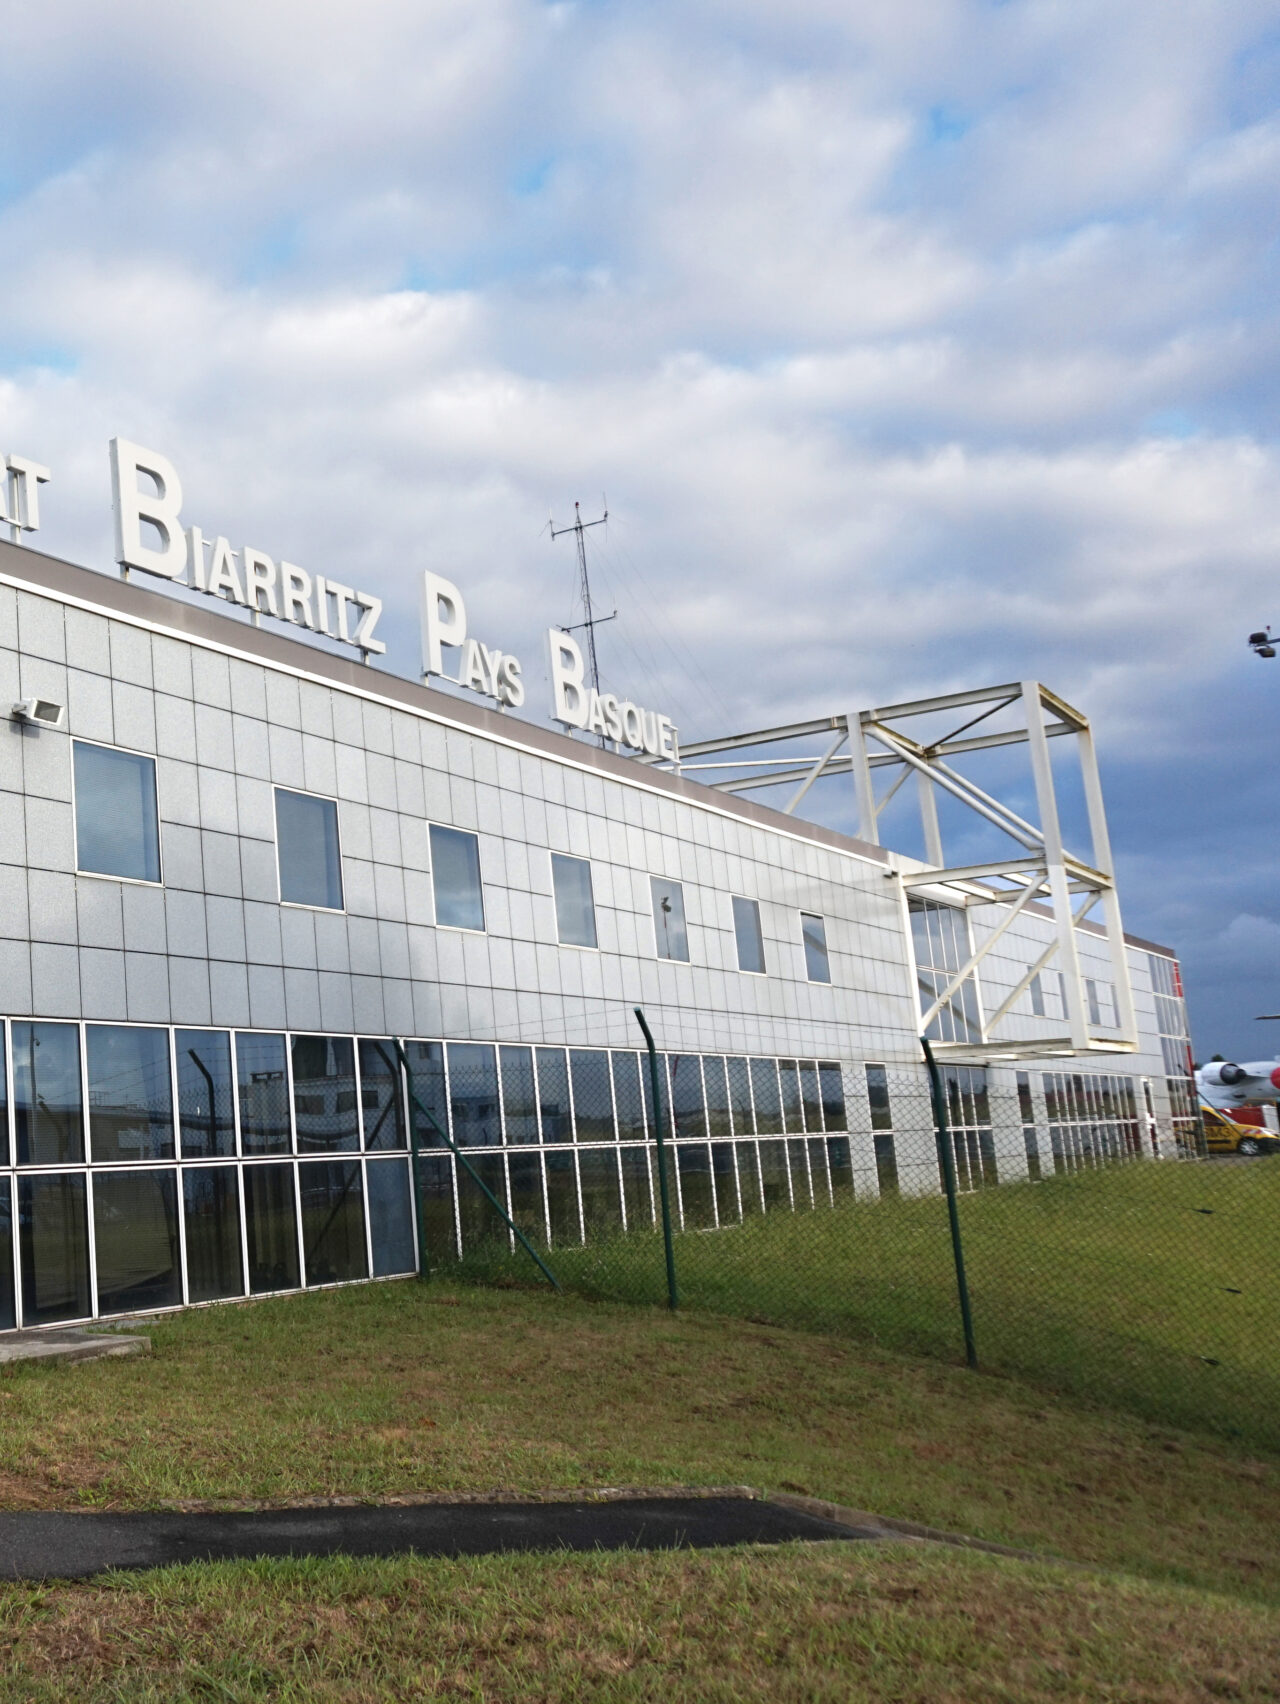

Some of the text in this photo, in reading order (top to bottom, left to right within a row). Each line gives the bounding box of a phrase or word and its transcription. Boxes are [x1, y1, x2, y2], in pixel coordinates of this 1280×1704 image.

[109, 436, 386, 655] BIARRITZ
[422, 570, 525, 708] PAYS
[545, 628, 676, 762] BASQUE
